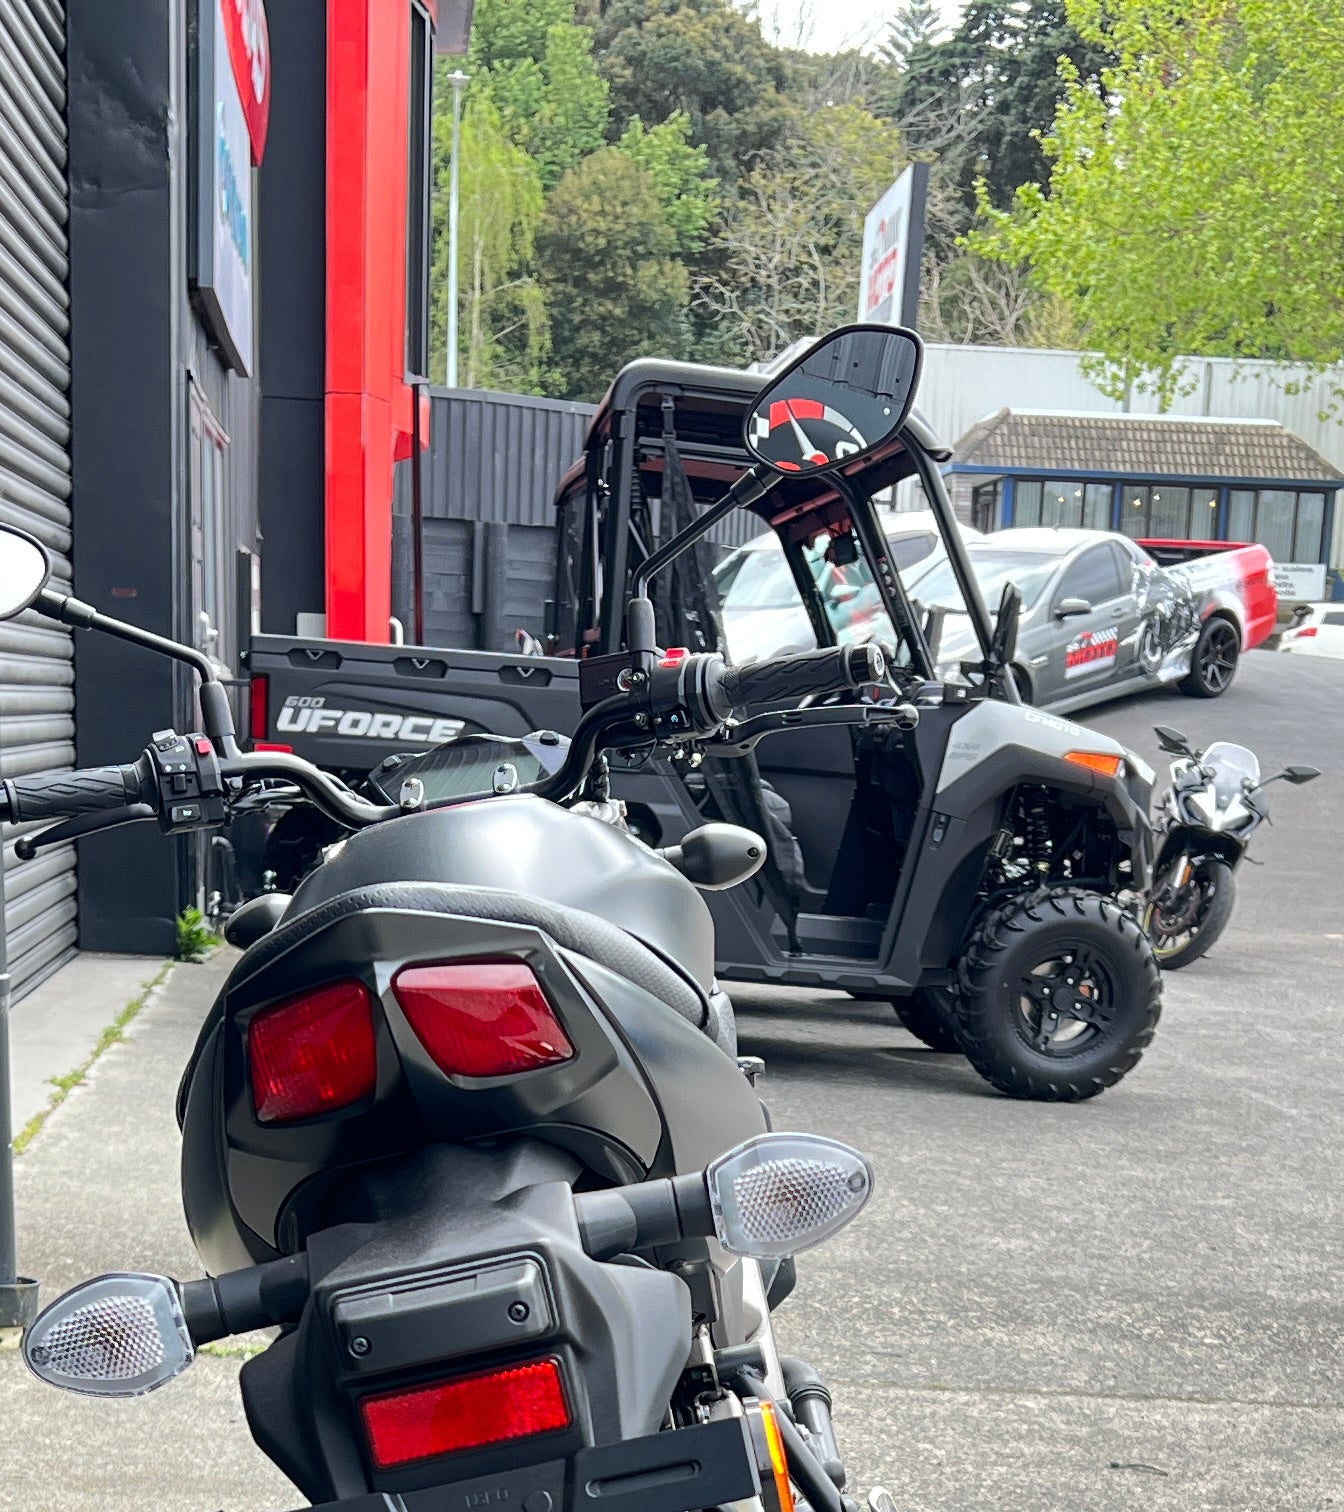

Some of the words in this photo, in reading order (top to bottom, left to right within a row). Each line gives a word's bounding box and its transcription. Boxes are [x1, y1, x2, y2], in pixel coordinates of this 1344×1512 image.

[1066, 640, 1118, 668] MOTO
[284, 696, 326, 708] 600
[276, 707, 465, 743] UFORCE
